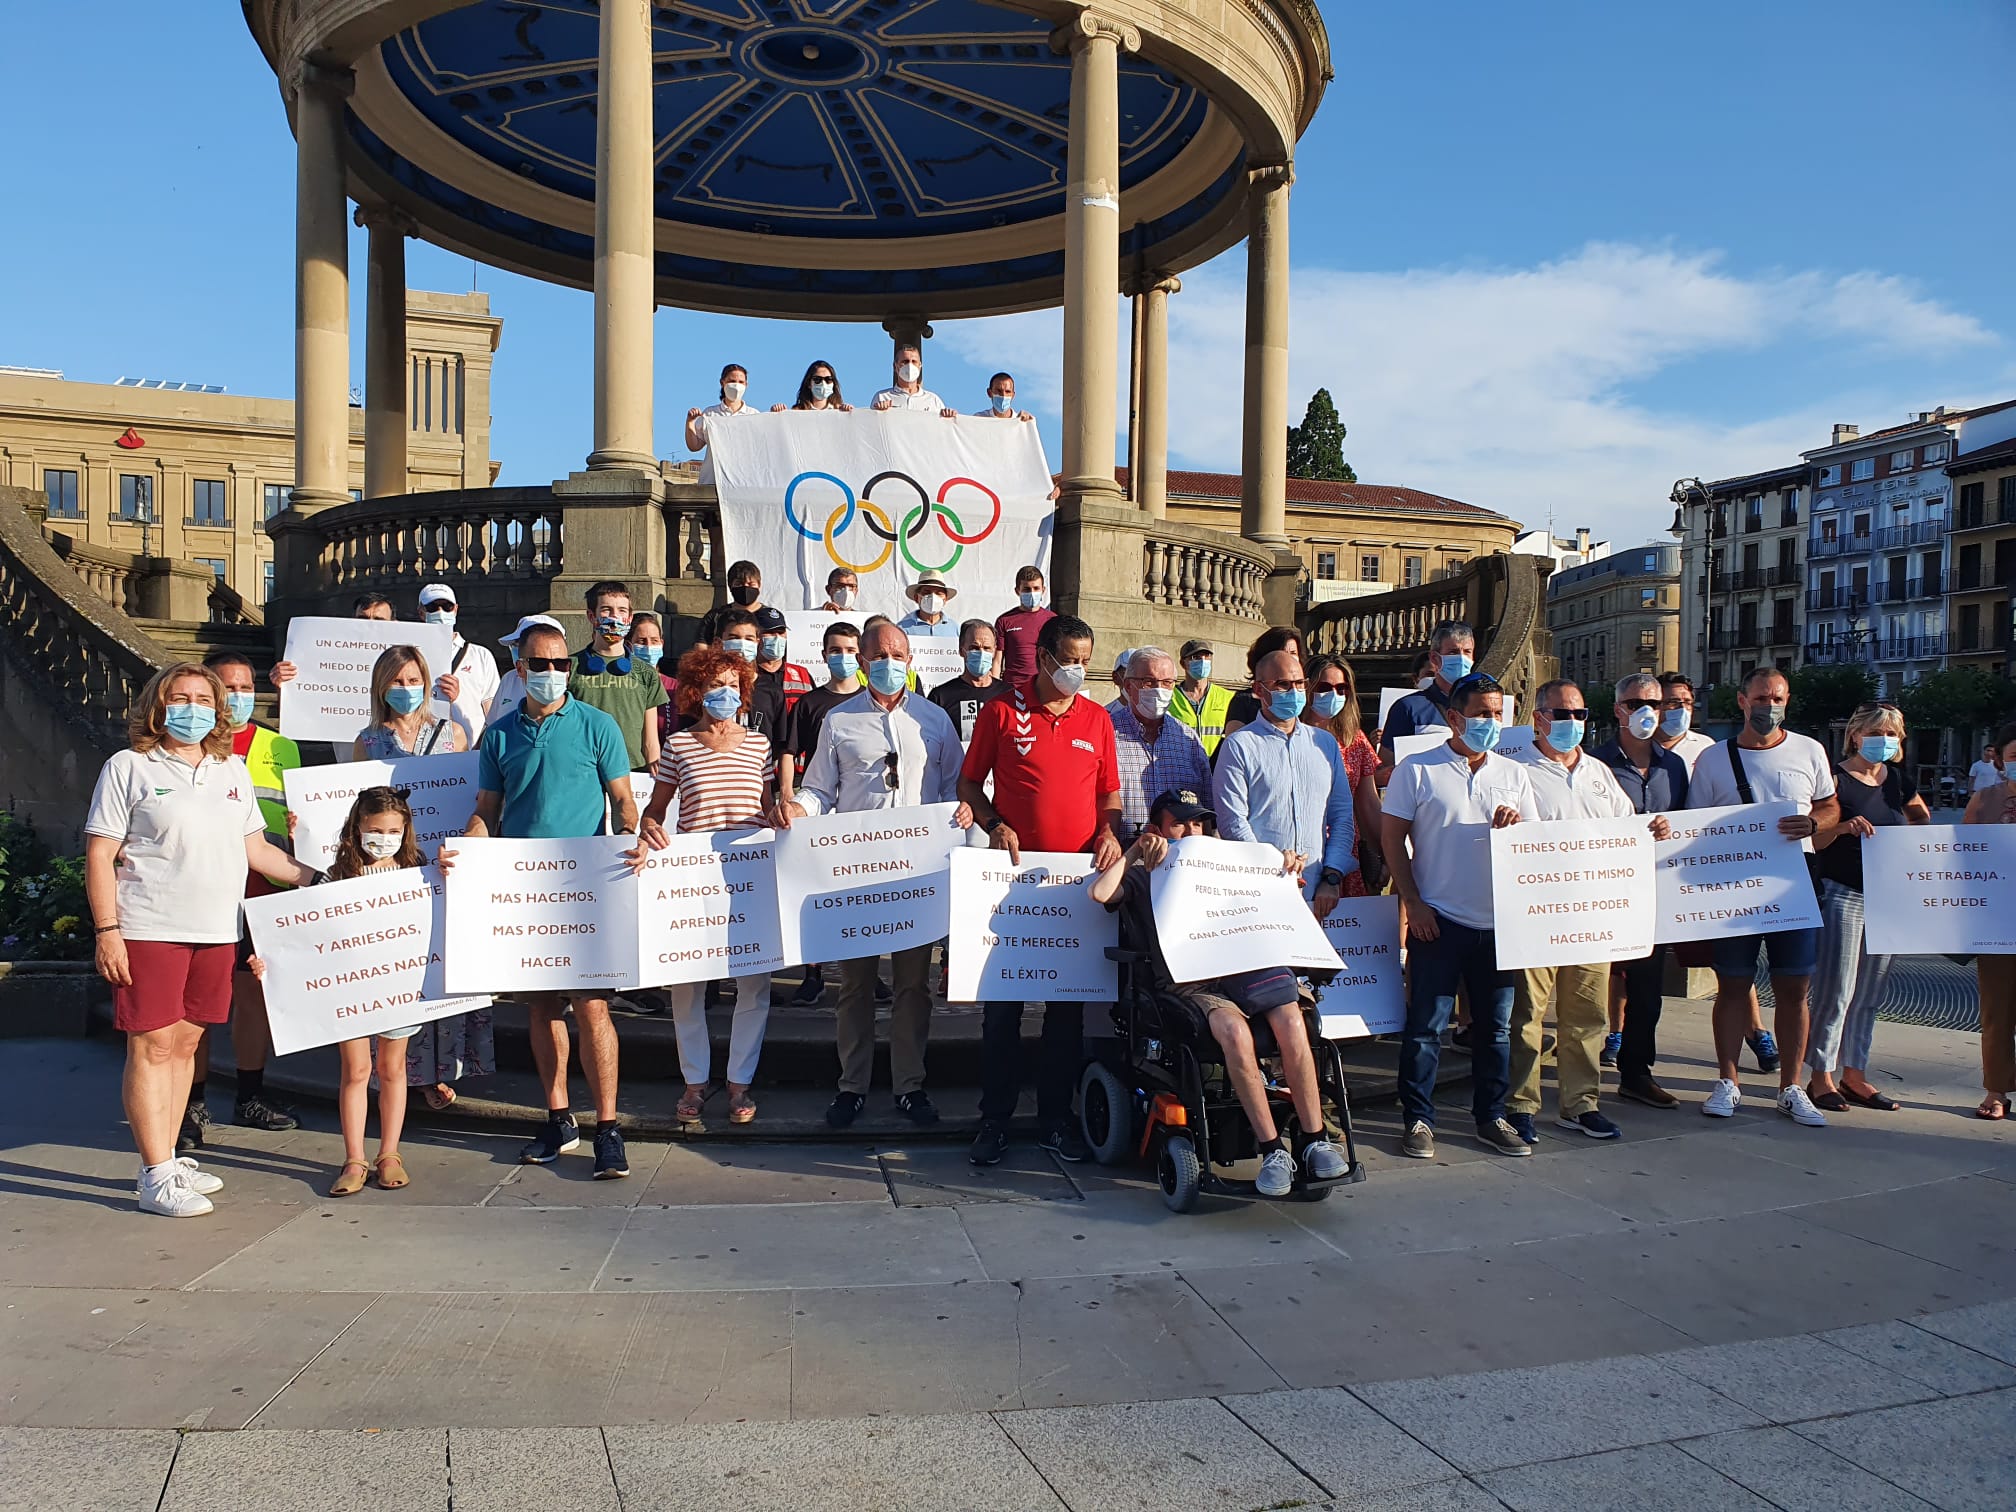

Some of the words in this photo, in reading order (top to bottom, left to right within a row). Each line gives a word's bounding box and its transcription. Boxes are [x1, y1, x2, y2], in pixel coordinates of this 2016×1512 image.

[1841, 487, 1862, 498] EL
[316, 640, 331, 648] UN
[335, 641, 387, 650] CAMPEON
[320, 662, 354, 671] MIEDO
[356, 664, 371, 672] DE
[296, 682, 334, 692] TODOS
[337, 684, 359, 694] LOS
[320, 706, 354, 715] MIEDO
[305, 792, 322, 802] LA
[325, 789, 356, 800] VIDA
[394, 776, 468, 791] DESTINADA
[410, 806, 440, 817] ETO,
[416, 828, 465, 842] ESAFIOS
[810, 836, 838, 848] LOS
[842, 826, 930, 844] GANADORES
[1672, 830, 1681, 840] O
[1684, 828, 1699, 839] SE
[1702, 825, 1746, 838] TRATA
[1750, 822, 1766, 833] DE
[1511, 842, 1556, 854] TIENES
[1559, 840, 1586, 852] QUE
[1588, 838, 1637, 850] ESPERAR
[1919, 844, 1930, 852] SI
[1934, 843, 1949, 852] SE
[1952, 842, 1990, 852] CREE
[514, 860, 577, 871] CUANTO
[646, 859, 657, 868] O
[662, 854, 715, 868] PUEDES
[718, 849, 769, 864] GANAR
[1667, 858, 1678, 868] SI
[1682, 856, 1696, 867] TE
[1700, 850, 1768, 866] DERRIBAN,
[832, 859, 914, 876] ENTRENAN,
[1177, 858, 1215, 870] TALENTO
[1216, 864, 1238, 873] GANA
[1238, 866, 1284, 877] PARTIDOS
[982, 871, 992, 881] SI
[994, 872, 1036, 884] TIENES
[1040, 874, 1084, 886] MIEDO
[1518, 872, 1560, 884] COSAS
[1564, 872, 1580, 882] DE
[1584, 870, 1594, 881] TI
[1598, 868, 1635, 880] MISMO
[1906, 872, 1914, 881] Y
[1918, 872, 1933, 881] SE
[656, 890, 666, 900] A
[670, 885, 720, 899] MENOS
[724, 881, 754, 895] QUE
[1195, 884, 1212, 895] PERO
[1213, 887, 1222, 896] EL
[1222, 888, 1262, 898] TRABAJO
[1680, 884, 1694, 894] SE
[1696, 880, 1744, 893] TRATA
[1746, 878, 1764, 888] DE
[491, 892, 521, 904] MAS
[526, 892, 597, 904] HACEMOS,
[814, 897, 843, 910] LOS
[846, 886, 936, 906] PERDEDORES
[1923, 898, 1938, 907] SE
[1942, 898, 1988, 907] PUEDE
[275, 916, 290, 928] SI
[294, 910, 320, 925] NO
[324, 901, 363, 919] ERES
[366, 884, 443, 909] VALIENTE
[990, 904, 1005, 915] AL
[1008, 905, 1072, 918] FRACASO,
[1206, 910, 1220, 918] EN
[1221, 906, 1259, 918] EQUIPO
[1528, 902, 1570, 916] ANTES
[1572, 902, 1589, 912] DE
[1592, 898, 1630, 912] PODER
[670, 913, 746, 930] APRENDAS
[1675, 914, 1686, 924] SI
[1689, 911, 1706, 922] TE
[1709, 904, 1781, 920] LEVANTAS
[492, 926, 524, 936] MAS
[528, 924, 596, 936] PODEMOS
[842, 927, 857, 938] SE
[861, 919, 914, 937] QUEJAN
[1188, 931, 1219, 940] GANA
[1220, 923, 1295, 936] CAMPEONATOS
[314, 943, 325, 954] Y
[330, 924, 422, 952] ARRIESGAS,
[982, 936, 1000, 946] NO
[1004, 936, 1018, 947] TE
[1022, 938, 1080, 948] MERECES
[1550, 930, 1614, 945] HACERLAS
[658, 949, 702, 964] COMO
[708, 942, 760, 958] PERDER
[1336, 944, 1389, 956] SFRUTAR
[521, 956, 572, 968] HACER
[306, 976, 331, 991] NO
[336, 964, 390, 985] HARAS
[394, 952, 442, 972] NADA
[1002, 968, 1014, 979] EL
[1018, 966, 1058, 980] ÉXITO
[336, 1004, 358, 1019] EN
[362, 999, 384, 1013] LA
[386, 990, 426, 1008] VIDA
